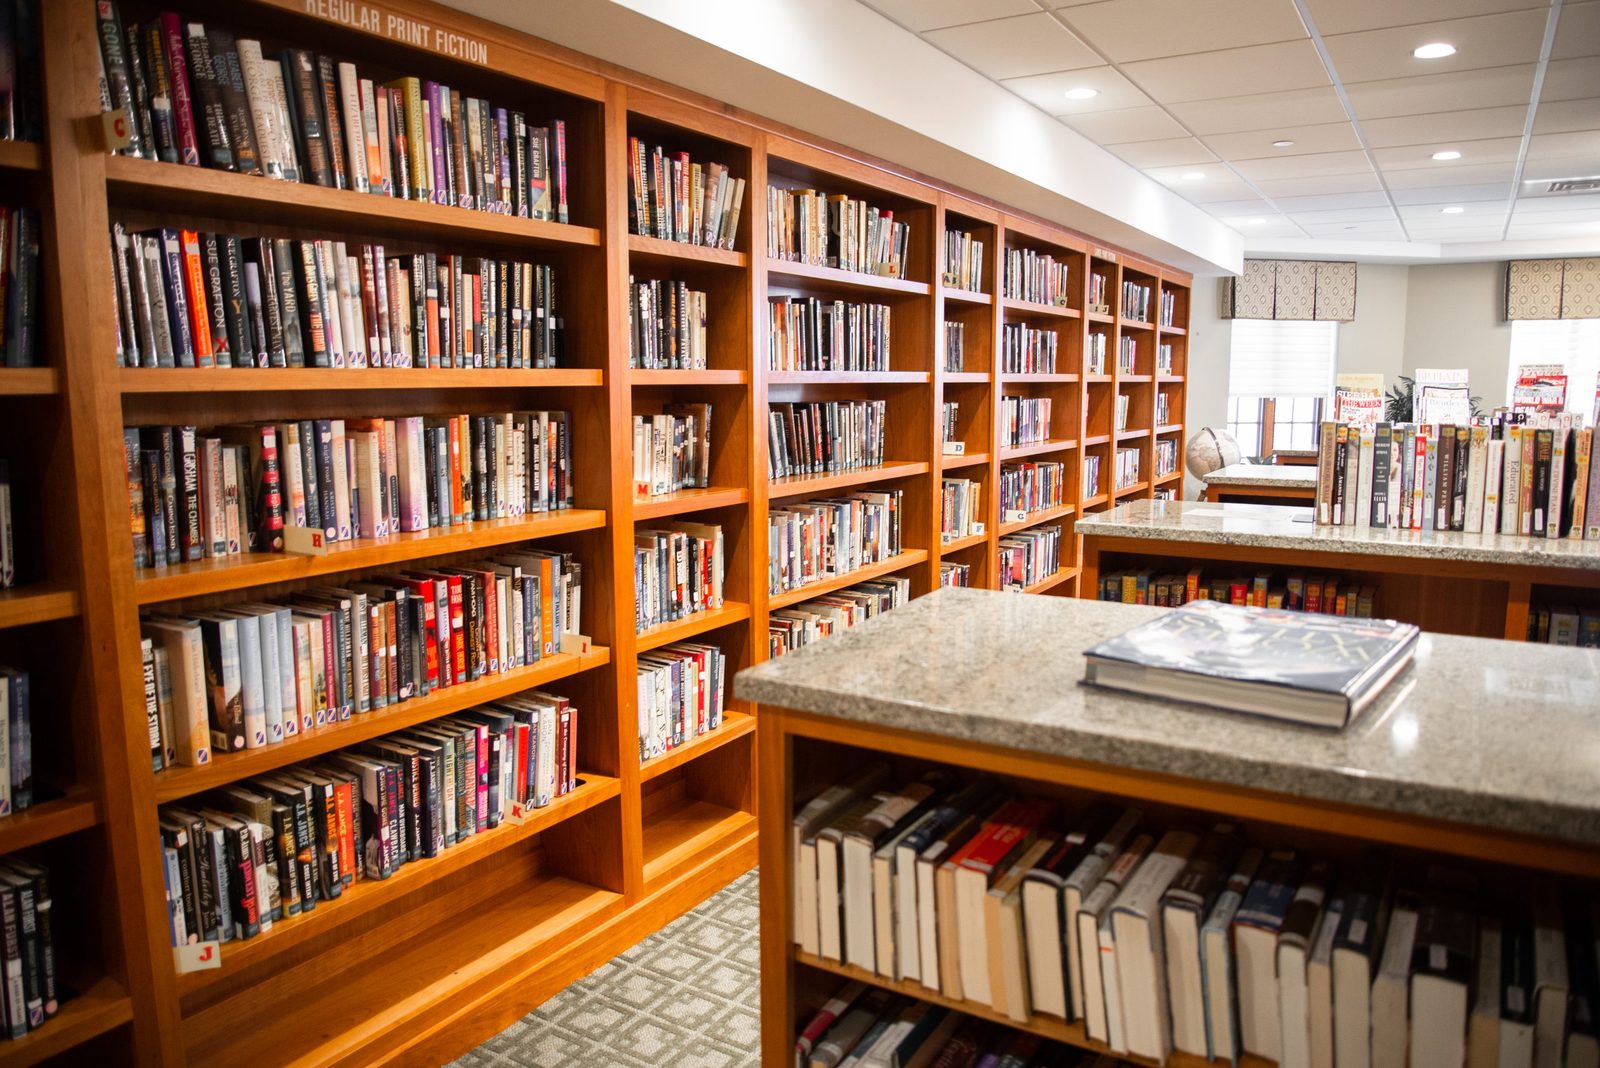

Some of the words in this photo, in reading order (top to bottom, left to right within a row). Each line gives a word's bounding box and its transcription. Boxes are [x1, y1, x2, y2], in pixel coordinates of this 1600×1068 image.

[102, 22, 122, 65] GONE
[305, 0, 380, 33] REGULAR
[387, 14, 429, 48] PRINT
[435, 29, 487, 64] FICTION
[189, 37, 206, 80] GEORGE
[201, 36, 215, 80] Elizabeth
[213, 54, 230, 86] GEORGE
[226, 51, 244, 92] ELIZABETH
[208, 117, 220, 146] DEATH
[532, 150, 541, 178] GRAFTON
[207, 240, 218, 264] SUE
[227, 238, 236, 256] SUE
[228, 256, 241, 297] GRAFTON
[209, 266, 226, 328] GRAFTON
[283, 287, 297, 313] YARD
[1359, 399, 1382, 409] WEEK
[162, 432, 170, 451] JOHN
[322, 444, 330, 464] night
[955, 444, 962, 452] D
[183, 454, 198, 492] GRISHAM
[268, 453, 277, 475] Water
[1442, 454, 1450, 488] WILLIAM
[270, 477, 278, 487] for
[638, 484, 648, 495] M
[1508, 460, 1520, 504] Educated
[187, 494, 197, 509] THE
[271, 489, 280, 525] Elephants
[188, 510, 199, 545] CHAMBER
[312, 533, 322, 548] H
[976, 525, 983, 533] F
[143, 664, 154, 682] EYE
[146, 696, 157, 715] THE
[147, 715, 161, 749] STORM
[446, 754, 454, 777] NIGHT
[296, 803, 306, 818] J.A.
[338, 809, 347, 836] JANCE
[512, 804, 523, 819] K
[298, 820, 309, 848] JANCE
[327, 813, 337, 839] JANCE
[389, 818, 399, 860] CLAWBACK
[266, 840, 276, 863] SIN
[284, 832, 296, 857] JANCE
[181, 858, 189, 892] comfort
[199, 856, 211, 907] Pemberley
[303, 863, 311, 880] CRUEL
[2, 894, 16, 923] ALAN
[21, 890, 34, 910] ALAN
[23, 910, 36, 934] FURST
[5, 925, 18, 959] FURST
[199, 946, 213, 961] J
